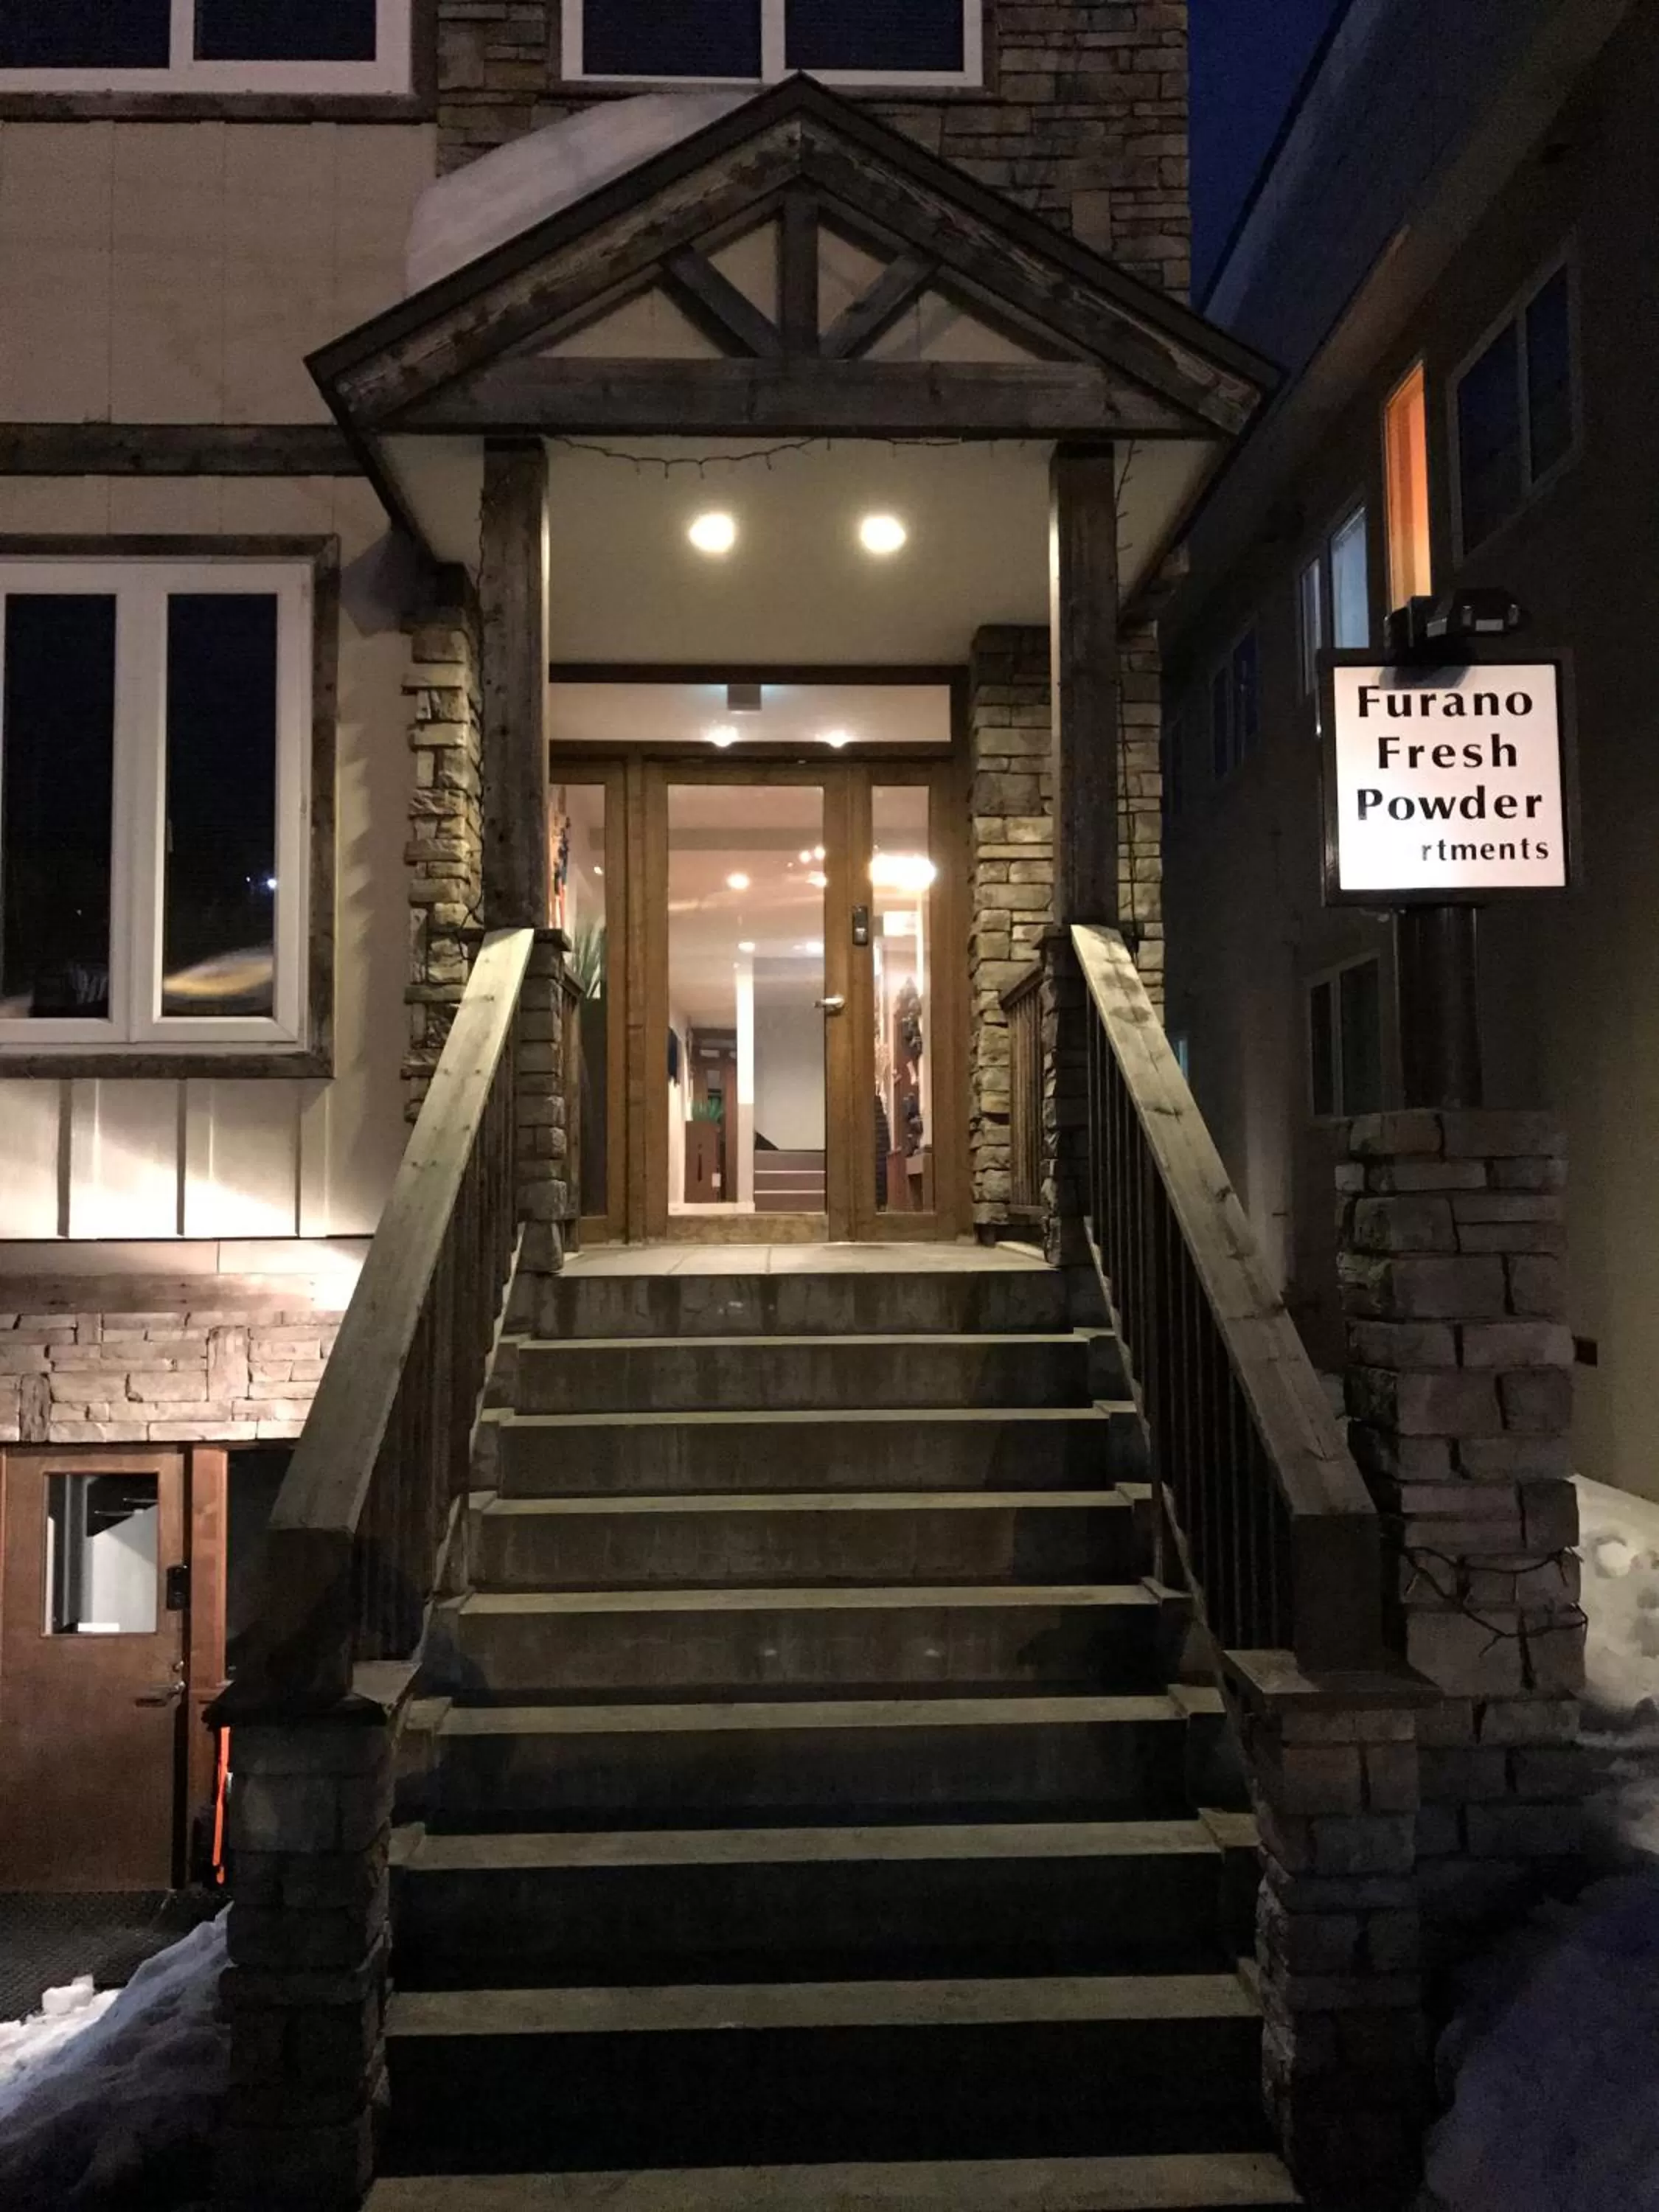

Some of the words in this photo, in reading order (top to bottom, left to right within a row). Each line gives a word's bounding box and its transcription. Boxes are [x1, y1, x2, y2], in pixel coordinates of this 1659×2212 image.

[1357, 685, 1533, 717] Furano
[1377, 733, 1517, 769] Fresh
[1357, 785, 1543, 820] Powder
[1422, 838, 1548, 860] rtments
